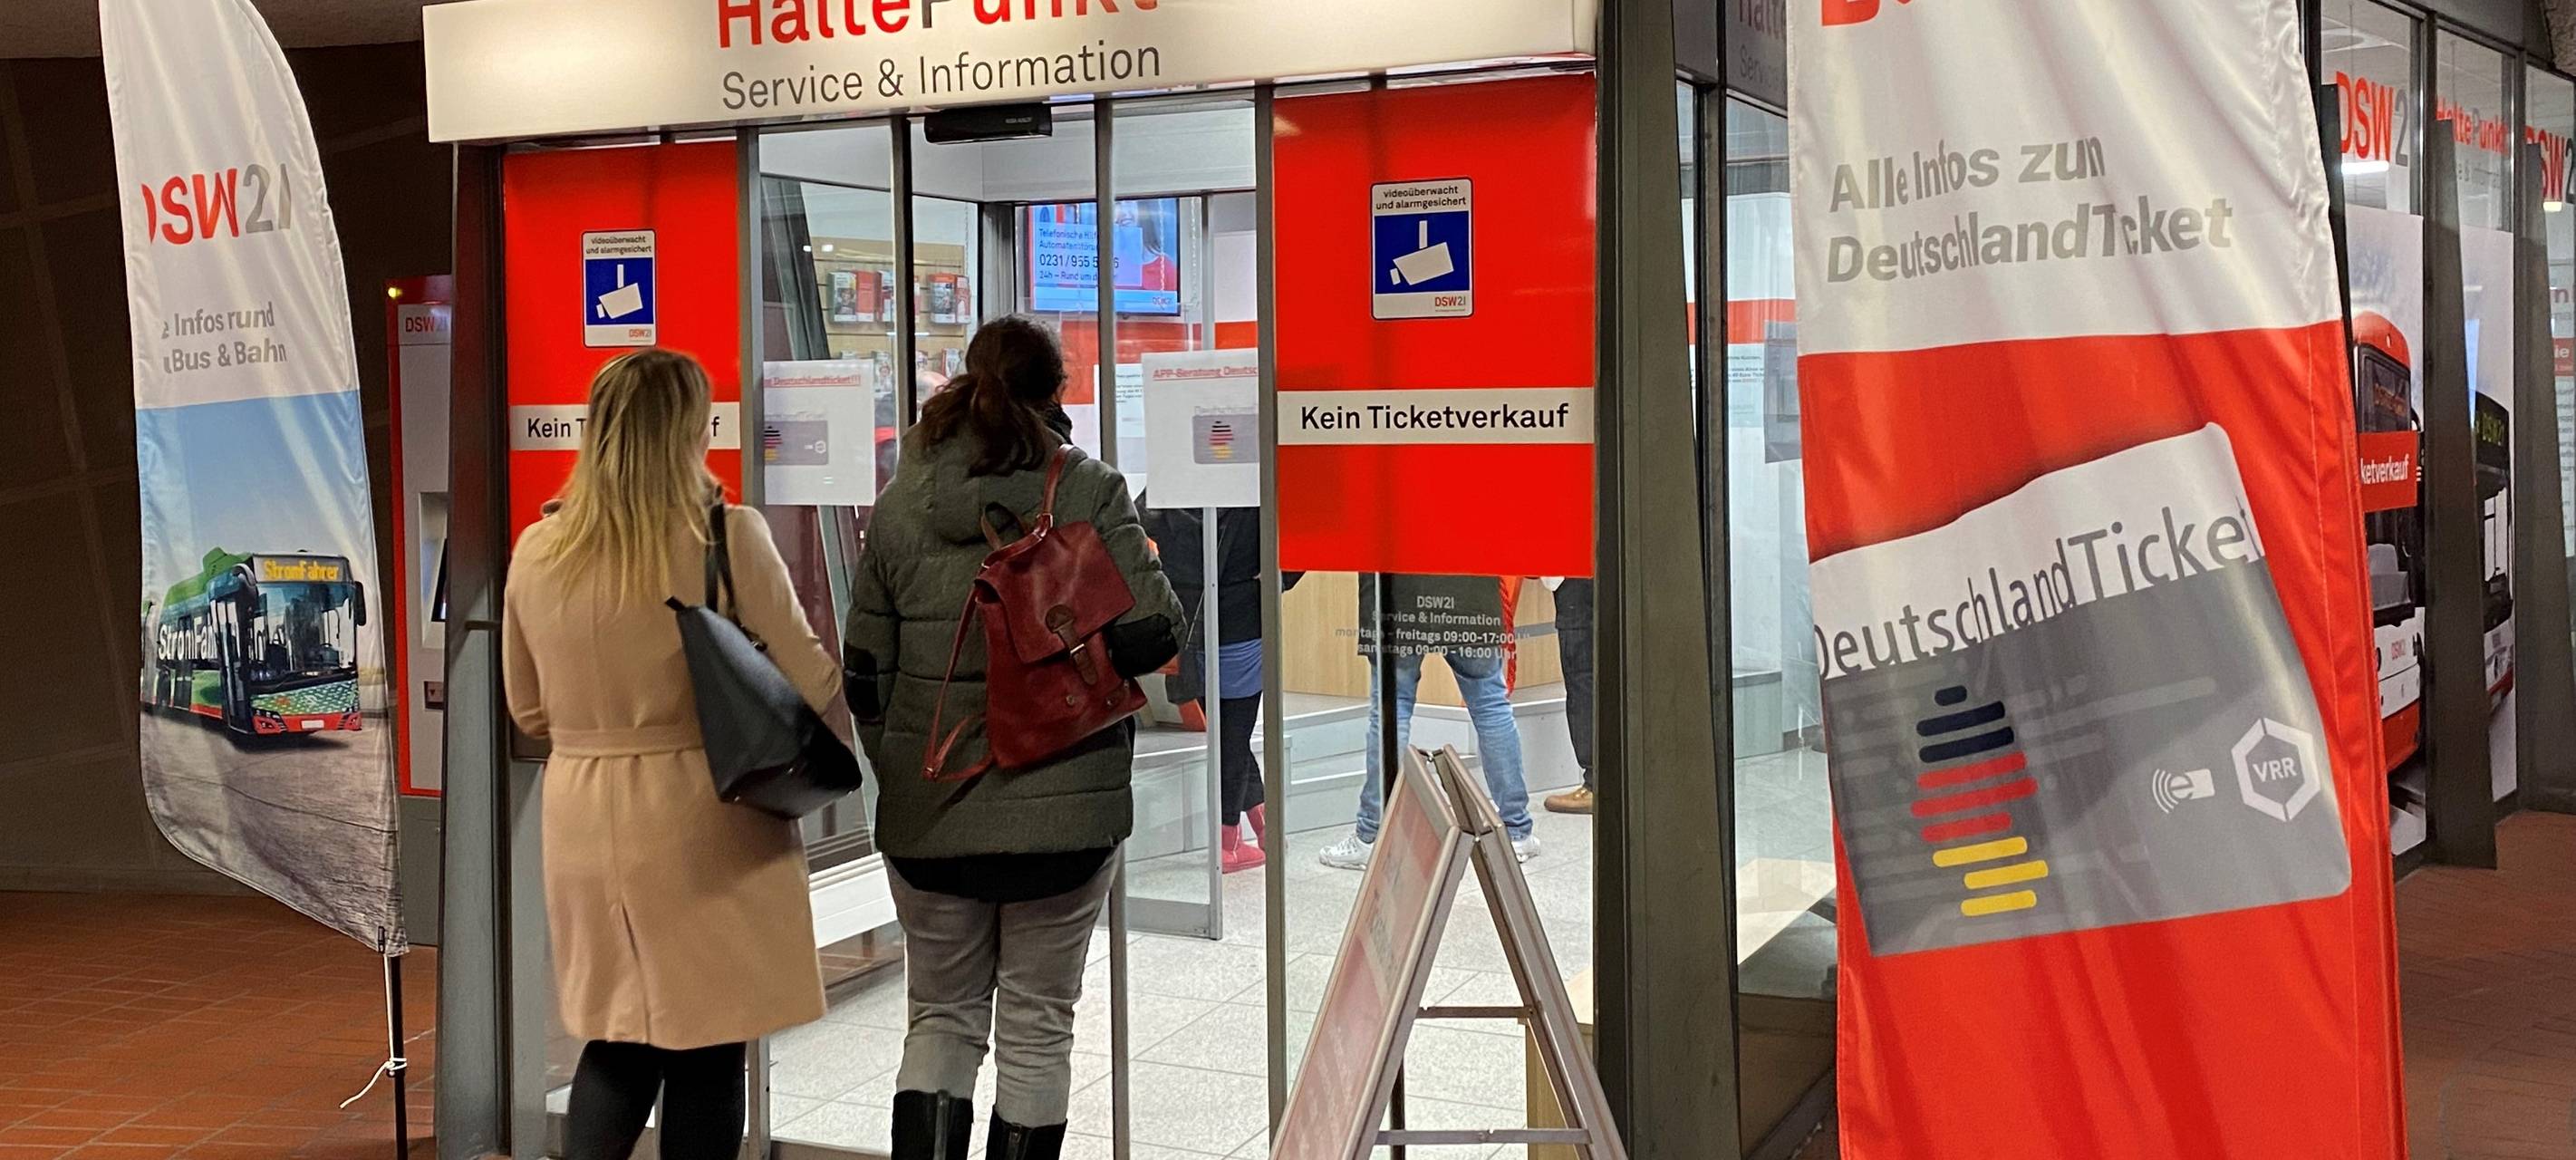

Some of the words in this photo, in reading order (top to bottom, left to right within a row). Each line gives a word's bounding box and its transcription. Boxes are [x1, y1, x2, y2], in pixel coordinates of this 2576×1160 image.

[720, 0, 1160, 48] Halte
[722, 64, 863, 110] Service
[878, 59, 904, 97] &
[919, 40, 1161, 93] Information
[2336, 71, 2408, 168] DSW2
[1828, 158, 1909, 213] Alle
[1912, 139, 2001, 200] Infos
[1383, 185, 1459, 198] videoüberwacht
[1375, 200, 1394, 210] und
[1395, 197, 1467, 210] alarmgesichert
[590, 236, 646, 245] videoüberwacht
[600, 245, 651, 256] alarmgesichert
[1826, 195, 2233, 284] DeutschlandTcket
[1434, 295, 1466, 306] DSW21
[174, 308, 225, 337] Infos
[227, 301, 275, 330] rund
[172, 348, 212, 373] Bus
[217, 343, 232, 367] &
[233, 338, 287, 366] Bahn
[1301, 406, 1361, 430] Kein
[1366, 402, 1569, 430] Ticketverkauf
[527, 418, 571, 438] Kein
[2359, 453, 2409, 485] ketverkauf
[264, 558, 340, 581] StromFahrer
[1416, 594, 1454, 609] DSW21
[1418, 611, 1428, 624] &
[1430, 612, 1500, 626] Information
[1395, 627, 1442, 644] freitags
[1358, 643, 1413, 658] samtags
[1459, 645, 1491, 658] 16:00
[2253, 757, 2298, 783] VRR
